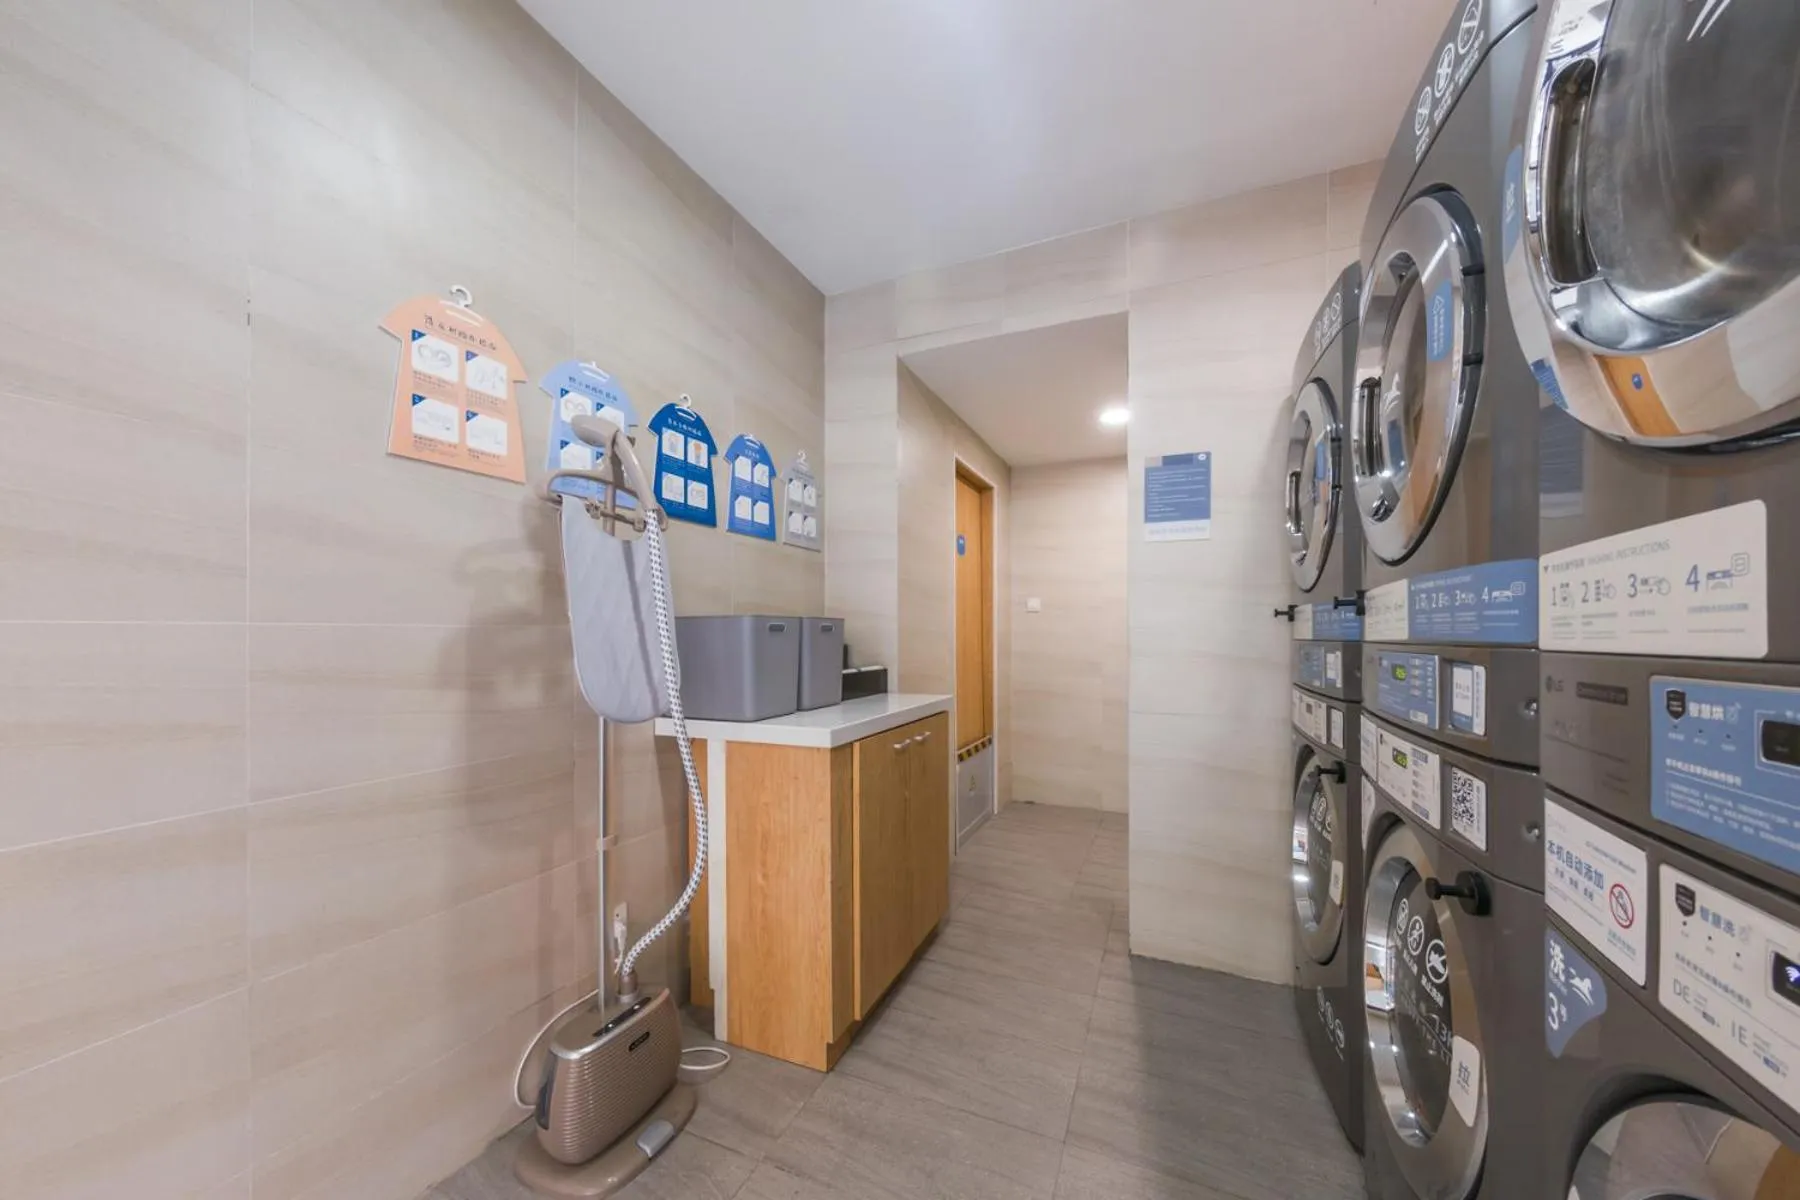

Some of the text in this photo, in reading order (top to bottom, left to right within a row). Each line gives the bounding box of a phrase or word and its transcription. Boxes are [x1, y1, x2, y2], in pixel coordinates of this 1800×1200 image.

[1481, 586, 1489, 604] 4
[1551, 563, 1700, 607] 1 2 3 4
[1547, 839, 1605, 891] 本机自动添加
[1549, 939, 1565, 983] 洗
[1673, 977, 1692, 1005] DE
